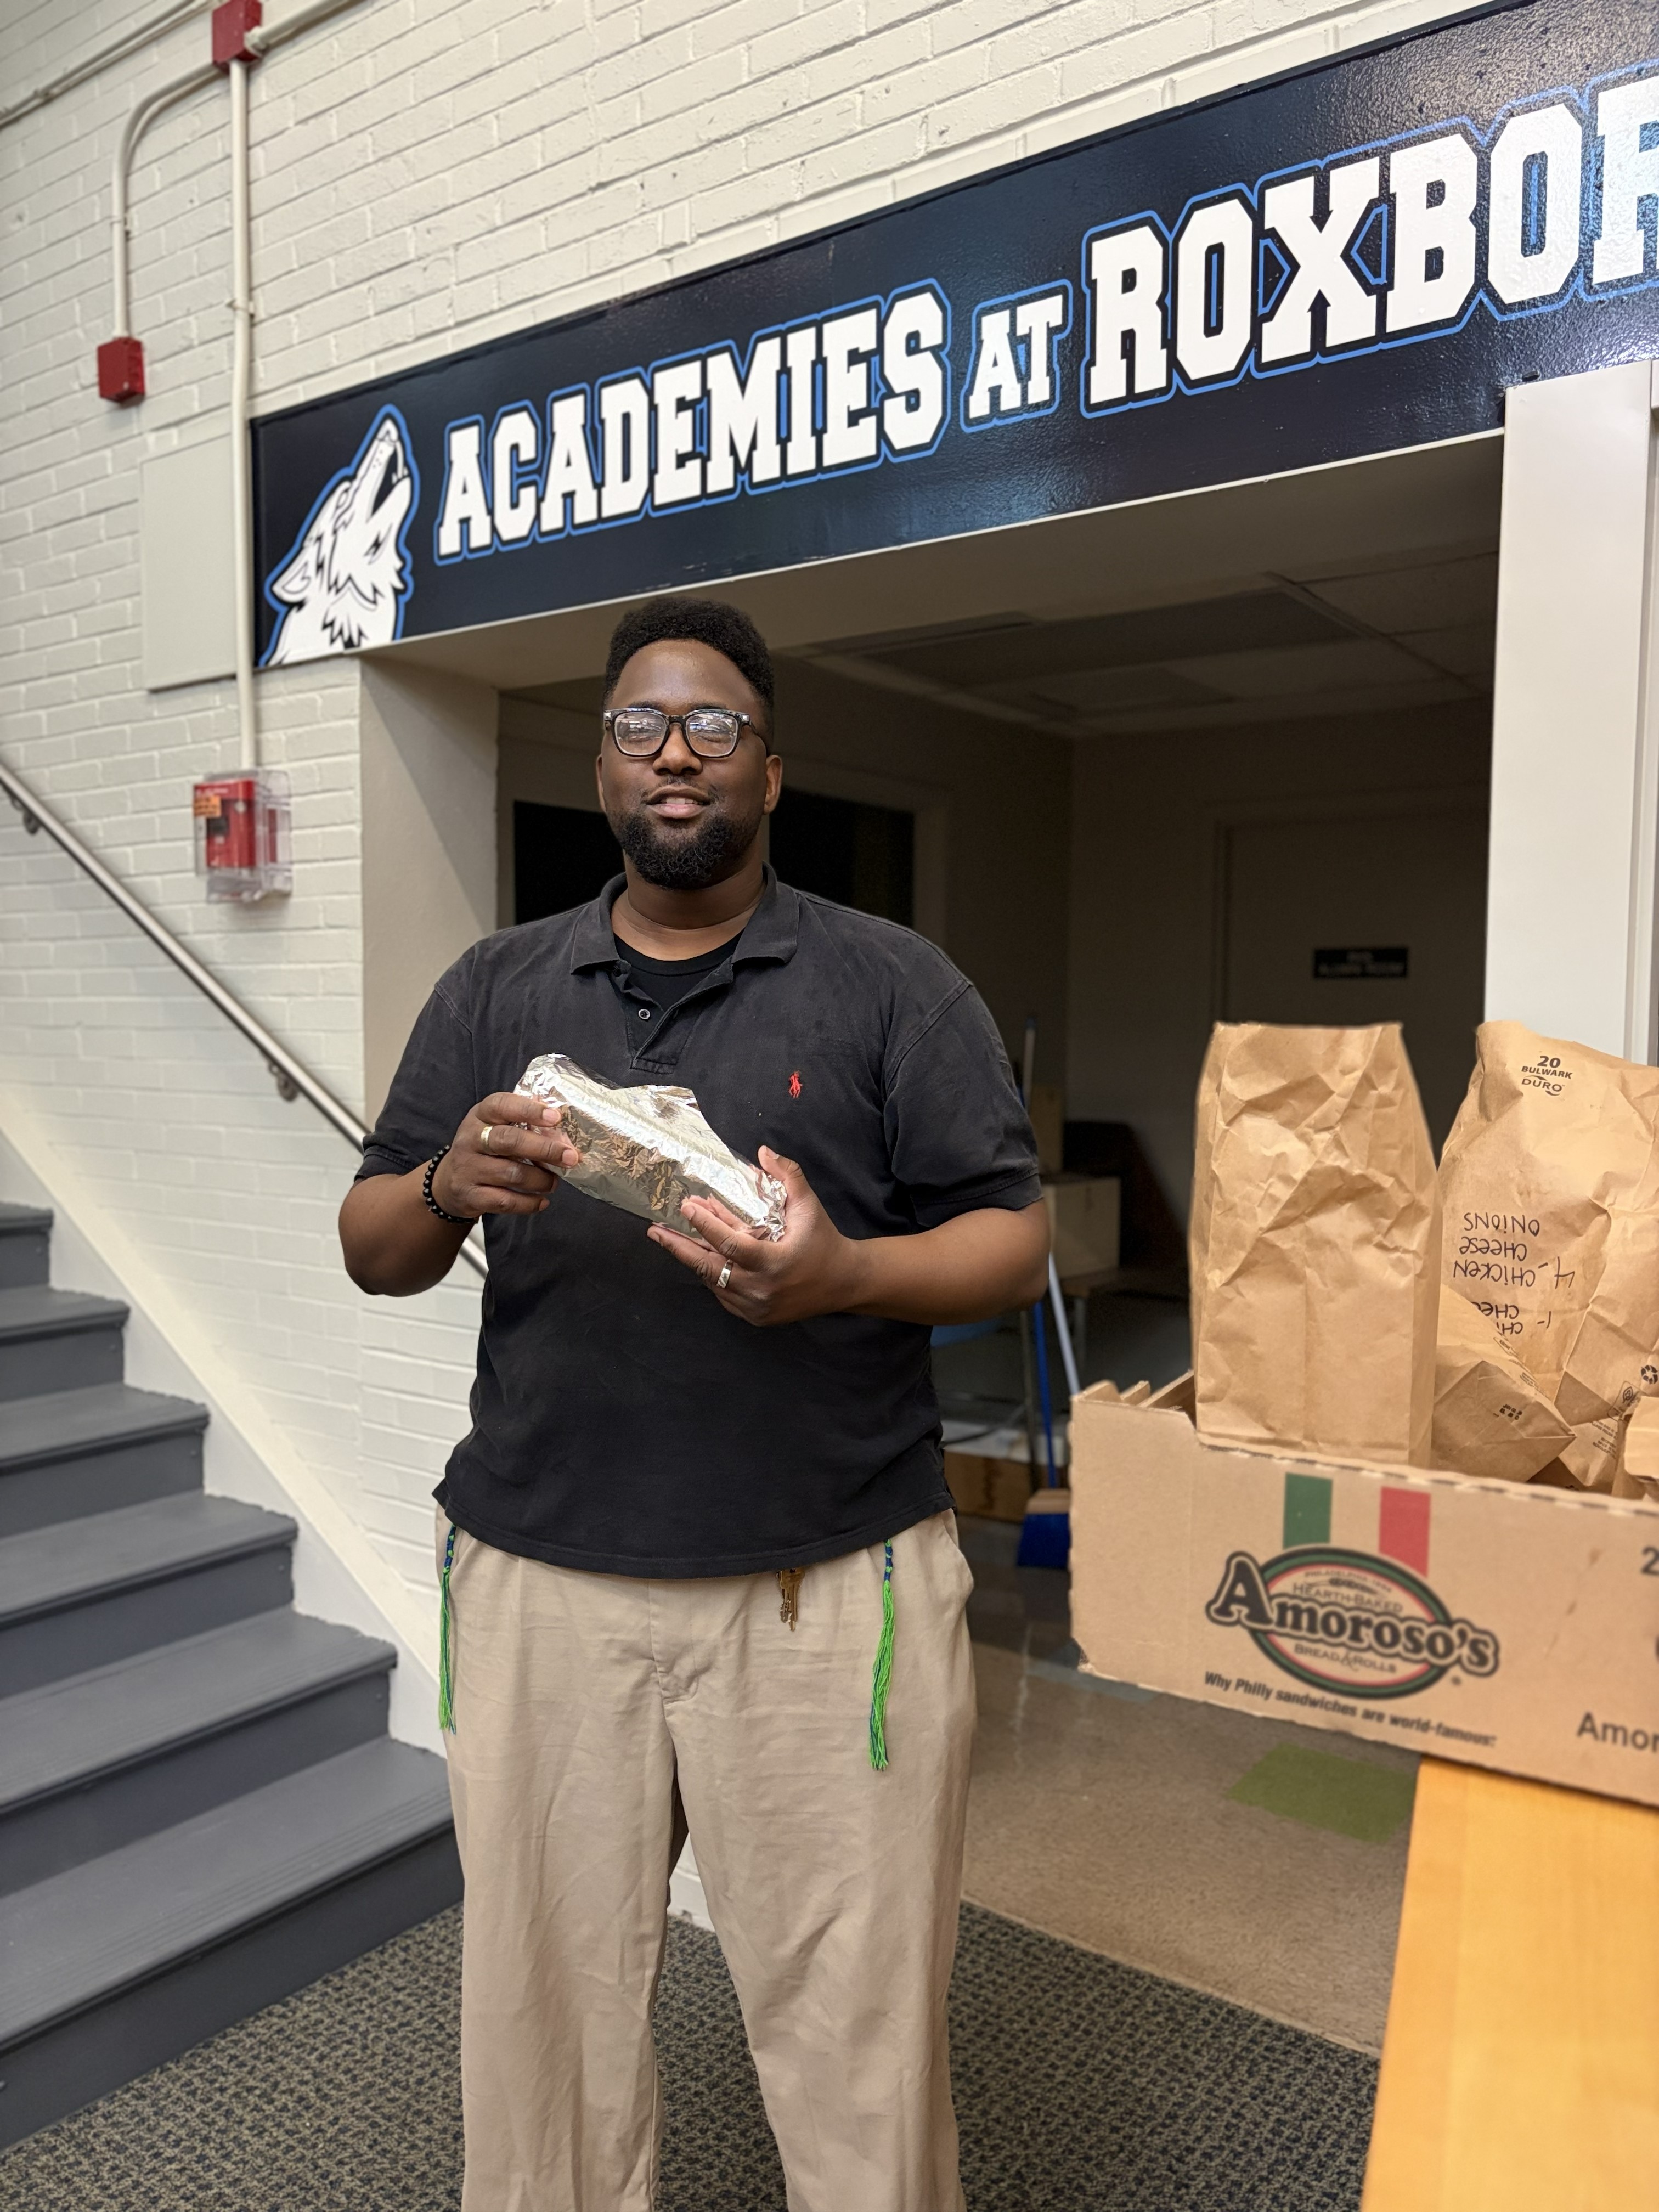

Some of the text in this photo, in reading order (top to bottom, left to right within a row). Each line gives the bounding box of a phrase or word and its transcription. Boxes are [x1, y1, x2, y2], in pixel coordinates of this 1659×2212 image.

[440, 76, 1659, 556] ACADEMIES AT ROXBOR
[1521, 1066, 1573, 1080] BULWARK
[1537, 1056, 1561, 1068] 20
[1521, 1078, 1562, 1092] DURO
[1294, 1643, 1340, 1662] BREAD
[1353, 1654, 1397, 1673] ROLLS
[1204, 1671, 1232, 1692] Why
[1234, 1678, 1273, 1701] Philly
[1275, 1689, 1358, 1717] sandwiches
[1361, 1708, 1385, 1724] are
